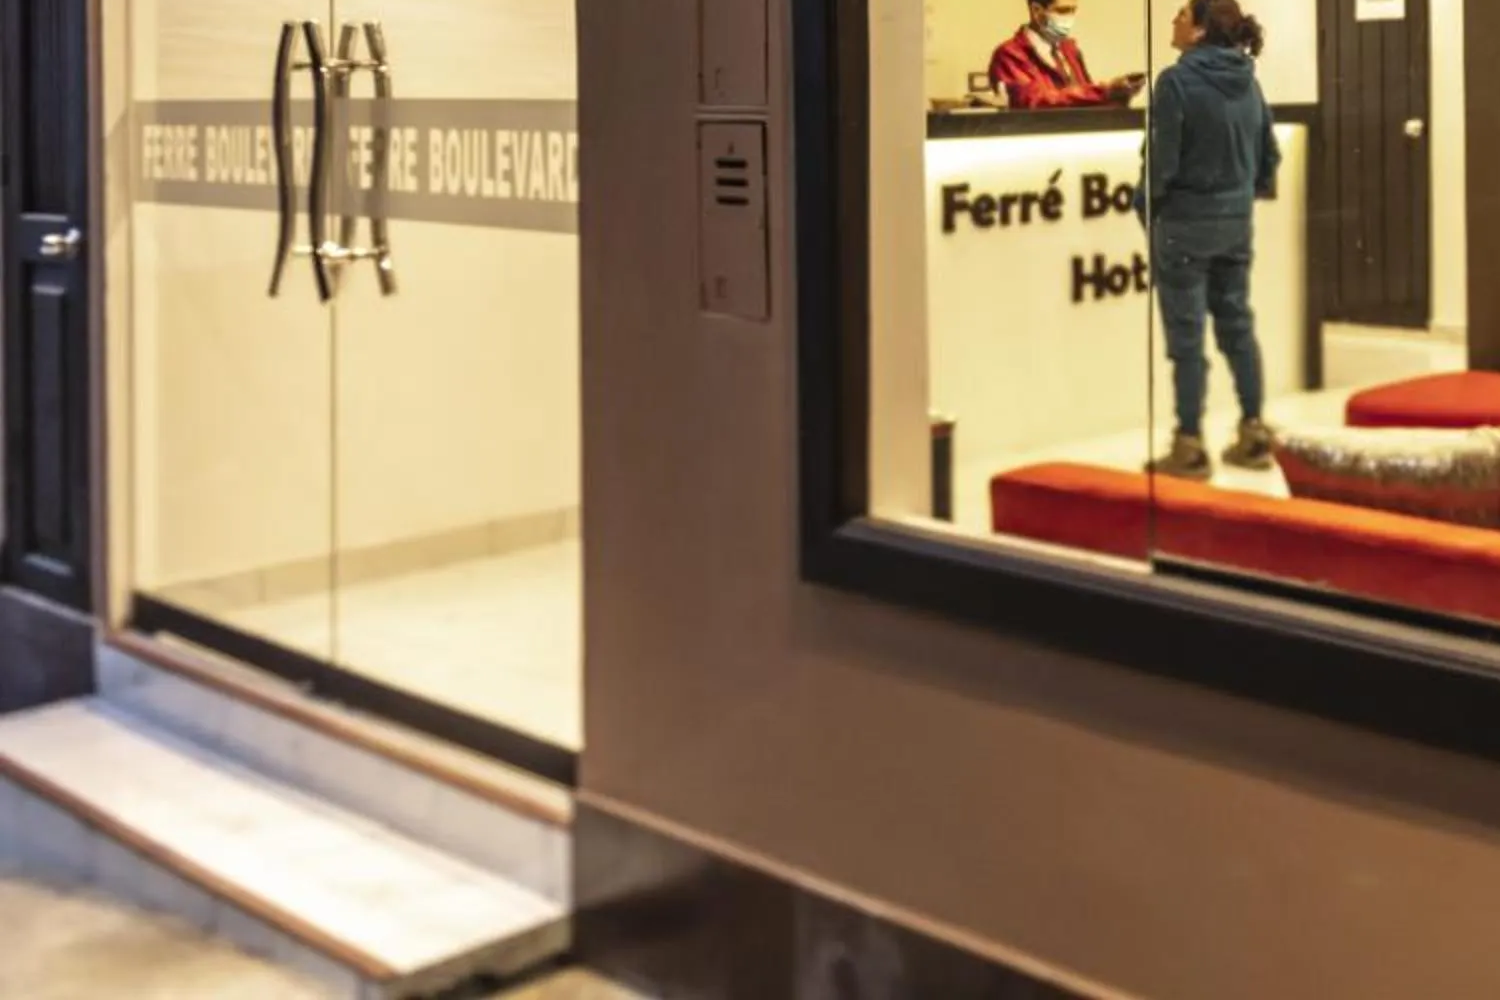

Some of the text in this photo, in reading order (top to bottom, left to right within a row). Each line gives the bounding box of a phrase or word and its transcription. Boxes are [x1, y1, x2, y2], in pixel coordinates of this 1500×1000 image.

[143, 124, 197, 182] FERRE
[347, 125, 418, 192] FERE
[940, 168, 1136, 235] Ferré Bo
[1071, 250, 1149, 304] Hot
